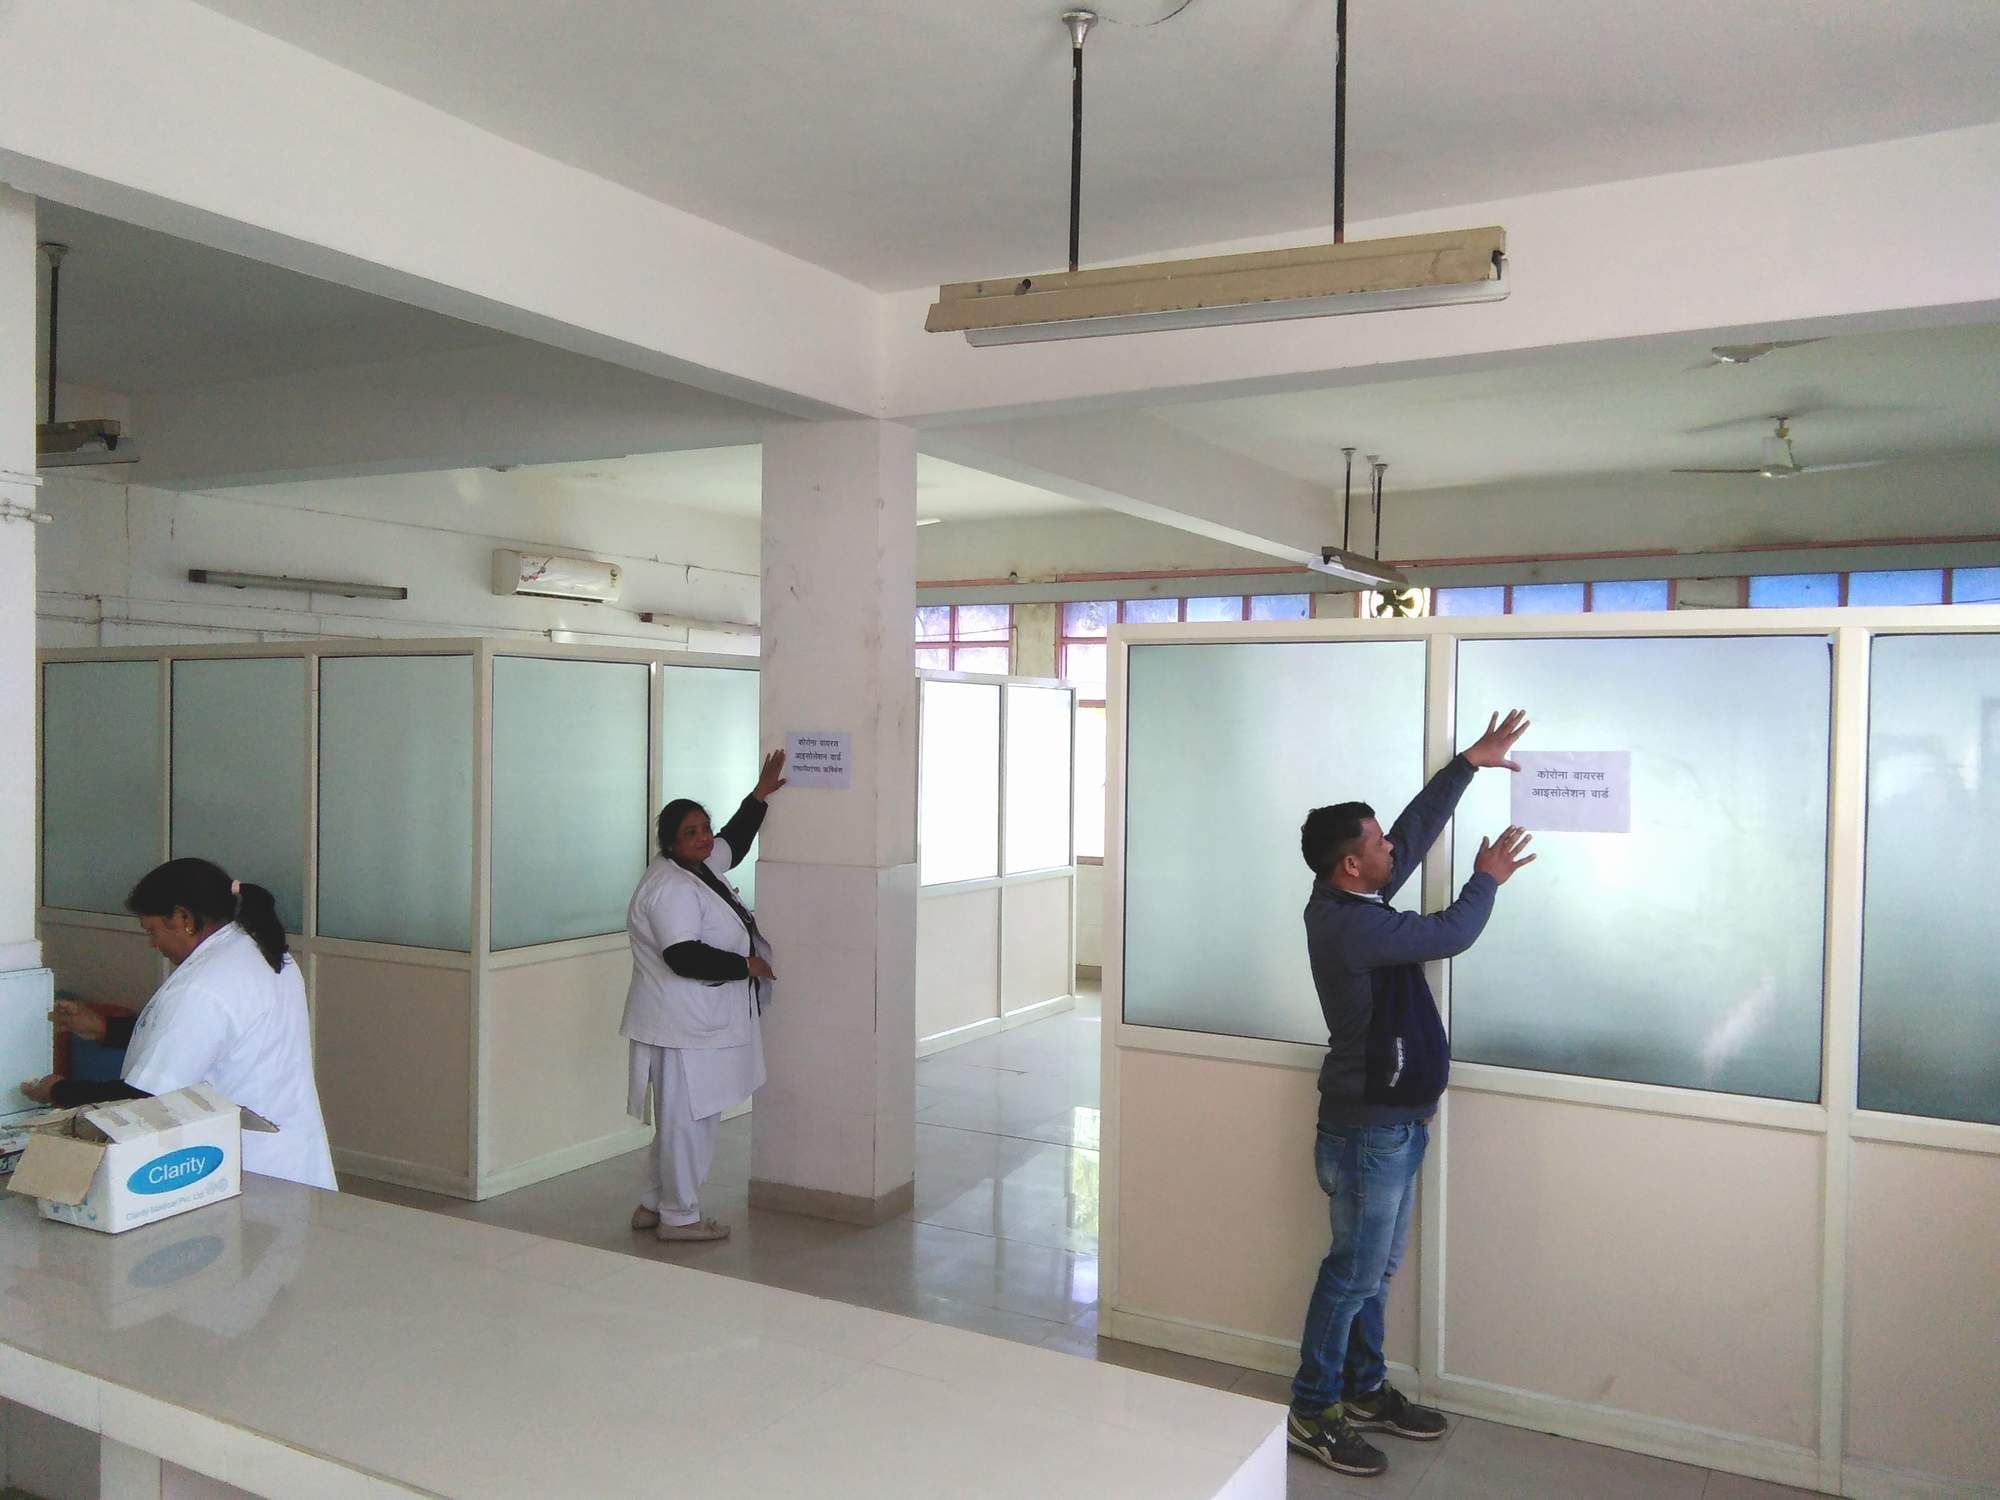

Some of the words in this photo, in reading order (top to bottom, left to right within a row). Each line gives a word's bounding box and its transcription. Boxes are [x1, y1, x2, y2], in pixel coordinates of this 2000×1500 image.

[798, 737, 817, 747] कोरोना
[1536, 767, 1568, 780] कोरोना
[1572, 771, 1605, 781] वायरस
[1531, 786, 1586, 798] आइसोलेशन
[1590, 786, 1610, 799] वार्ड
[148, 1155, 206, 1185] Clarity
